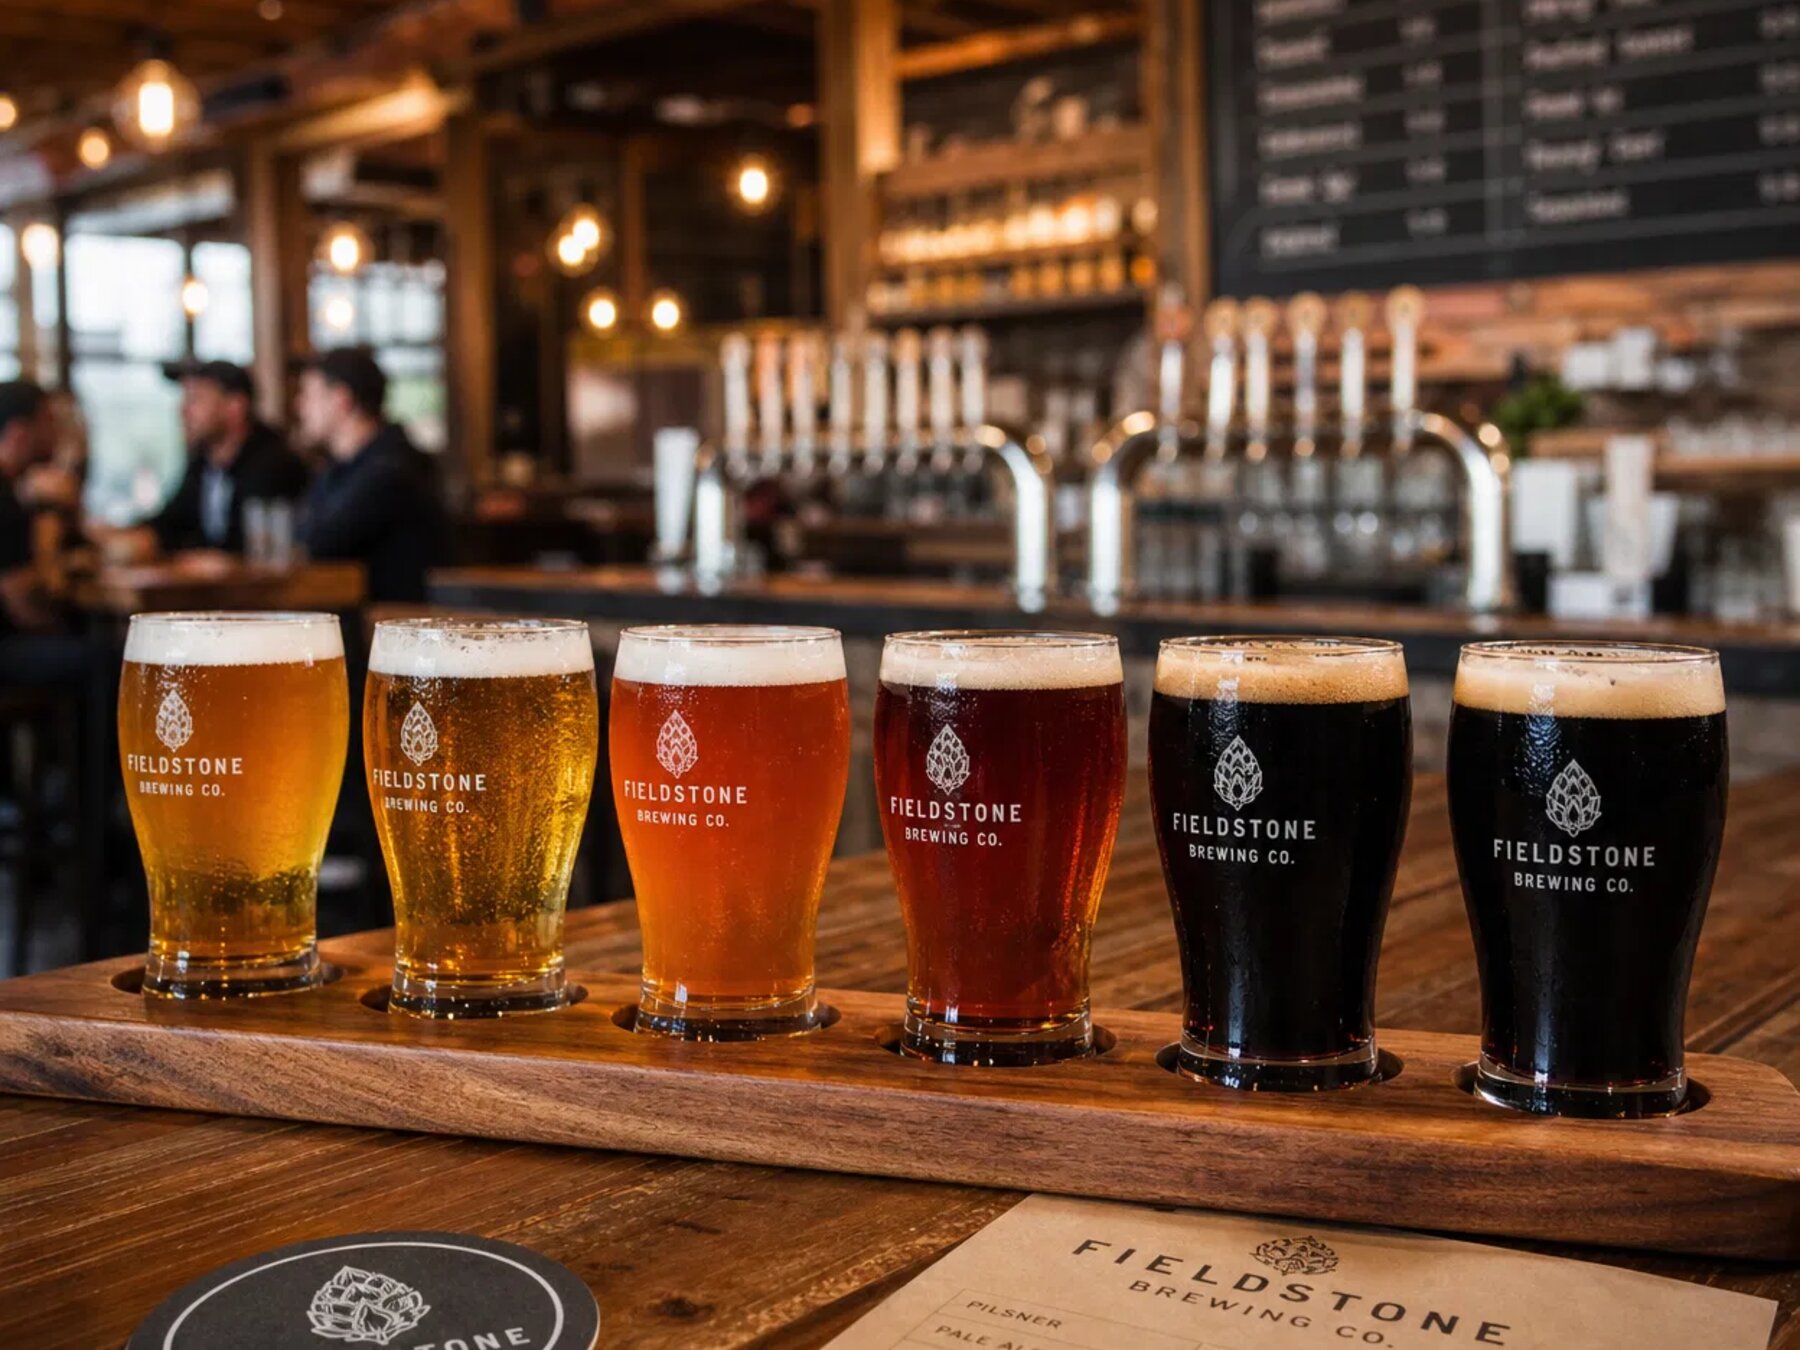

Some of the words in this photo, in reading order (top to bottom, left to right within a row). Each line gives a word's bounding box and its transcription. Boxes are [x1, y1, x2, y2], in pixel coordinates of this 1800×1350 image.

[127, 753, 243, 775] FIELDSTONE
[139, 781, 194, 797] BREWING
[201, 784, 226, 797] CO.
[373, 768, 487, 791] FIELDSTONE
[624, 780, 747, 804] FIELDSTONE
[384, 796, 438, 813] BREWING
[446, 800, 470, 814] CO.
[890, 796, 1022, 823] FIELDSTONE
[637, 809, 698, 826] BREWING
[705, 814, 730, 828] CO.
[1173, 812, 1316, 840] FIELDSTONE
[905, 827, 969, 845] BREWING
[977, 831, 1003, 846] CO.
[1189, 844, 1259, 864] BREWING
[1268, 849, 1296, 865] CO.
[1493, 838, 1656, 867] FIELDSTONE
[1513, 872, 1596, 892] BREWING
[1606, 878, 1634, 893] CO.
[1072, 1239, 1511, 1346] FIELDSTONE
[966, 1301, 1062, 1329] PILSNER
[1129, 1280, 1313, 1328] BREWING
[1335, 1325, 1394, 1348] CO.
[935, 1325, 991, 1346] PALE
